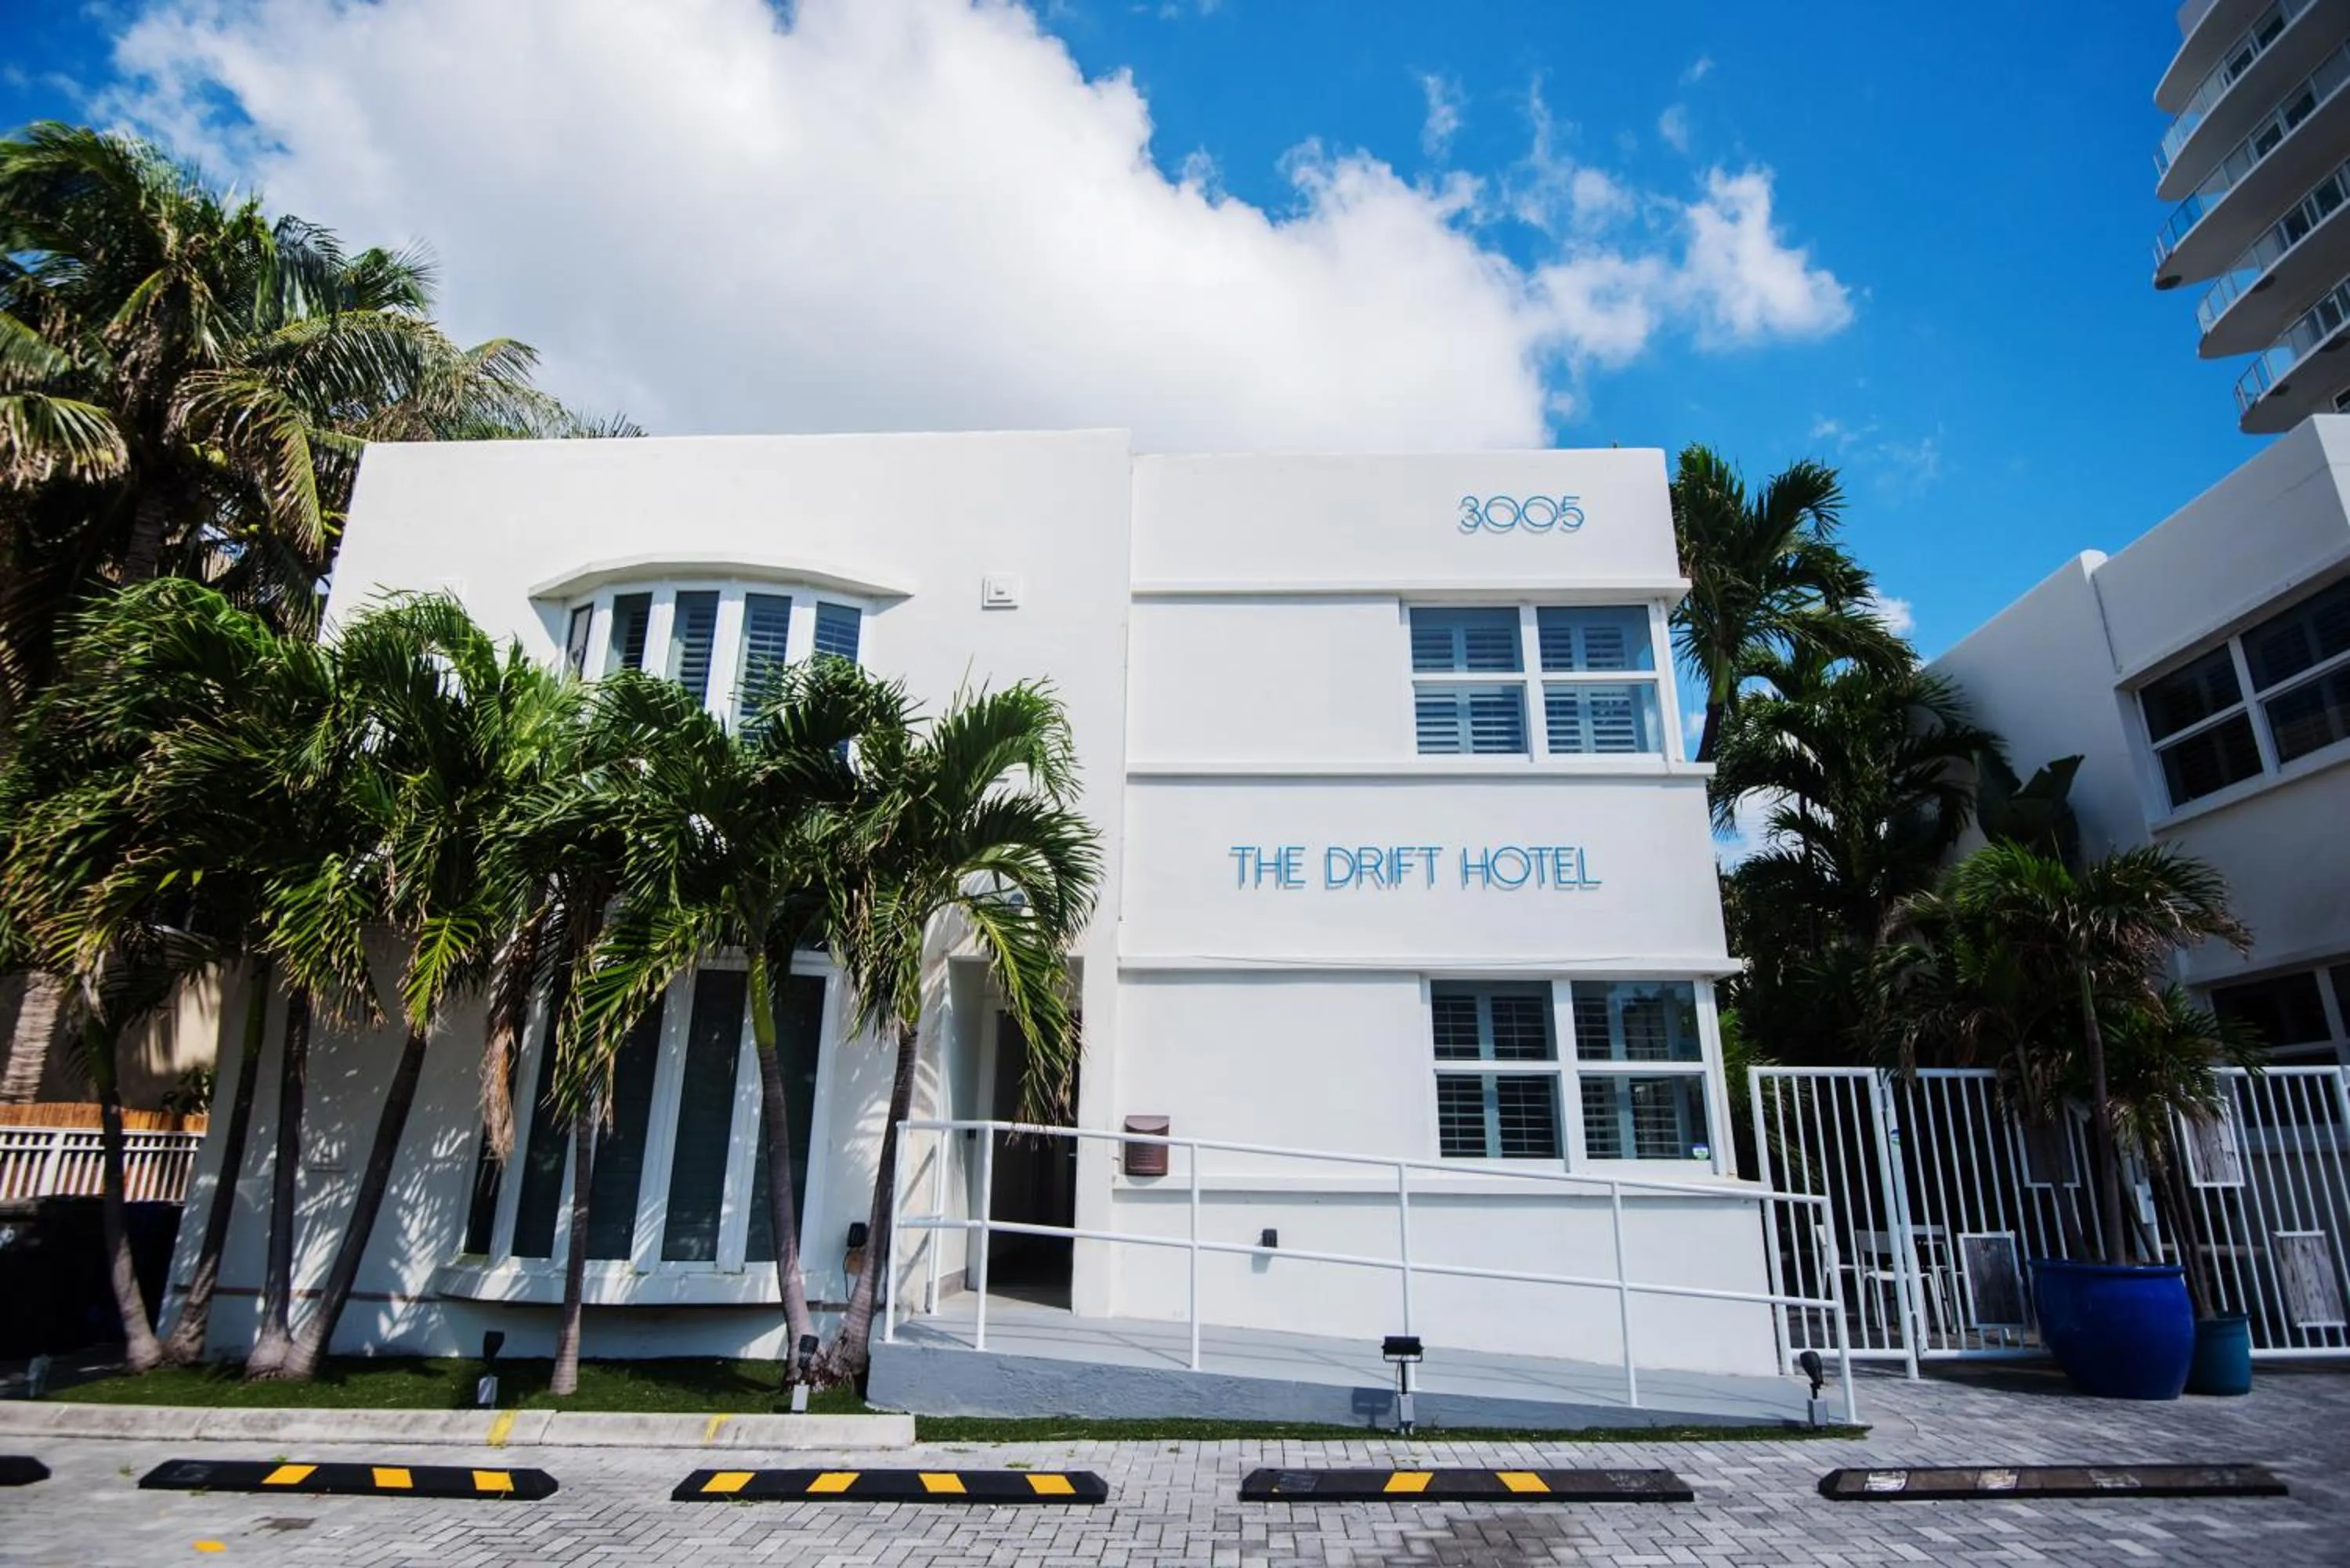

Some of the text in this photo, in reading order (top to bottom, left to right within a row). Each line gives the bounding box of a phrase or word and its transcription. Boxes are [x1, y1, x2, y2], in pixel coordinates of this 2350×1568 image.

[1460, 495, 1585, 528] 3005
[1231, 846, 1603, 885] THE DRIFT HOTEL
